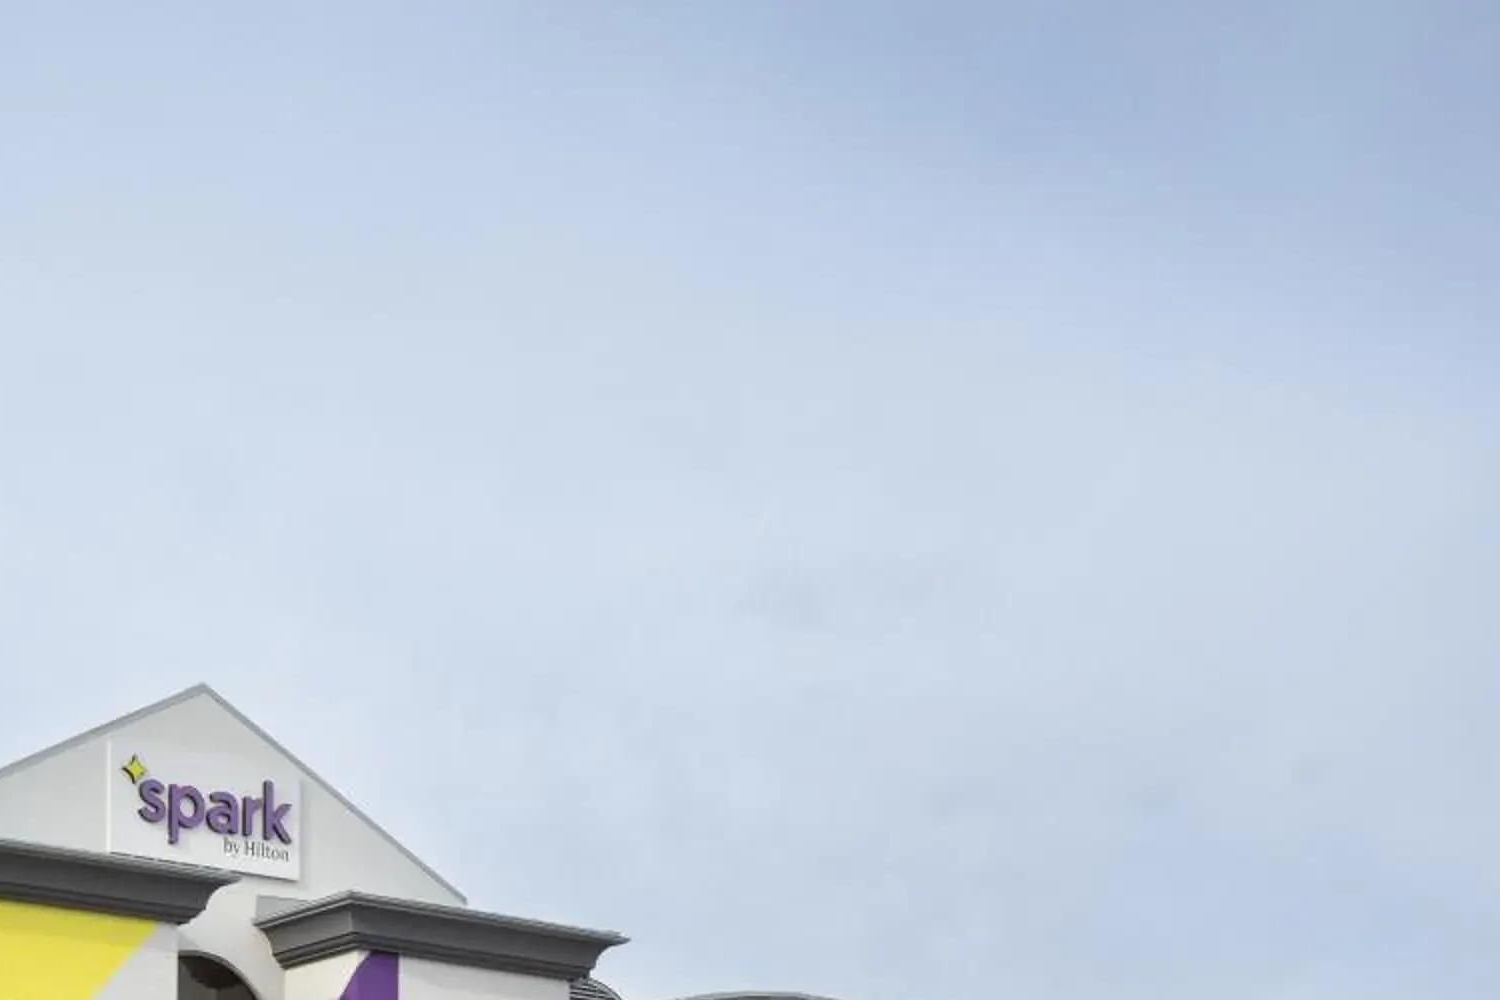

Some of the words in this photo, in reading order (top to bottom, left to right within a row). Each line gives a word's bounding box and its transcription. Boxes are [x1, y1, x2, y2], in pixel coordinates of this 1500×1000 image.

[137, 778, 292, 844] spark
[223, 837, 240, 855] by
[243, 838, 289, 862] Hilton
